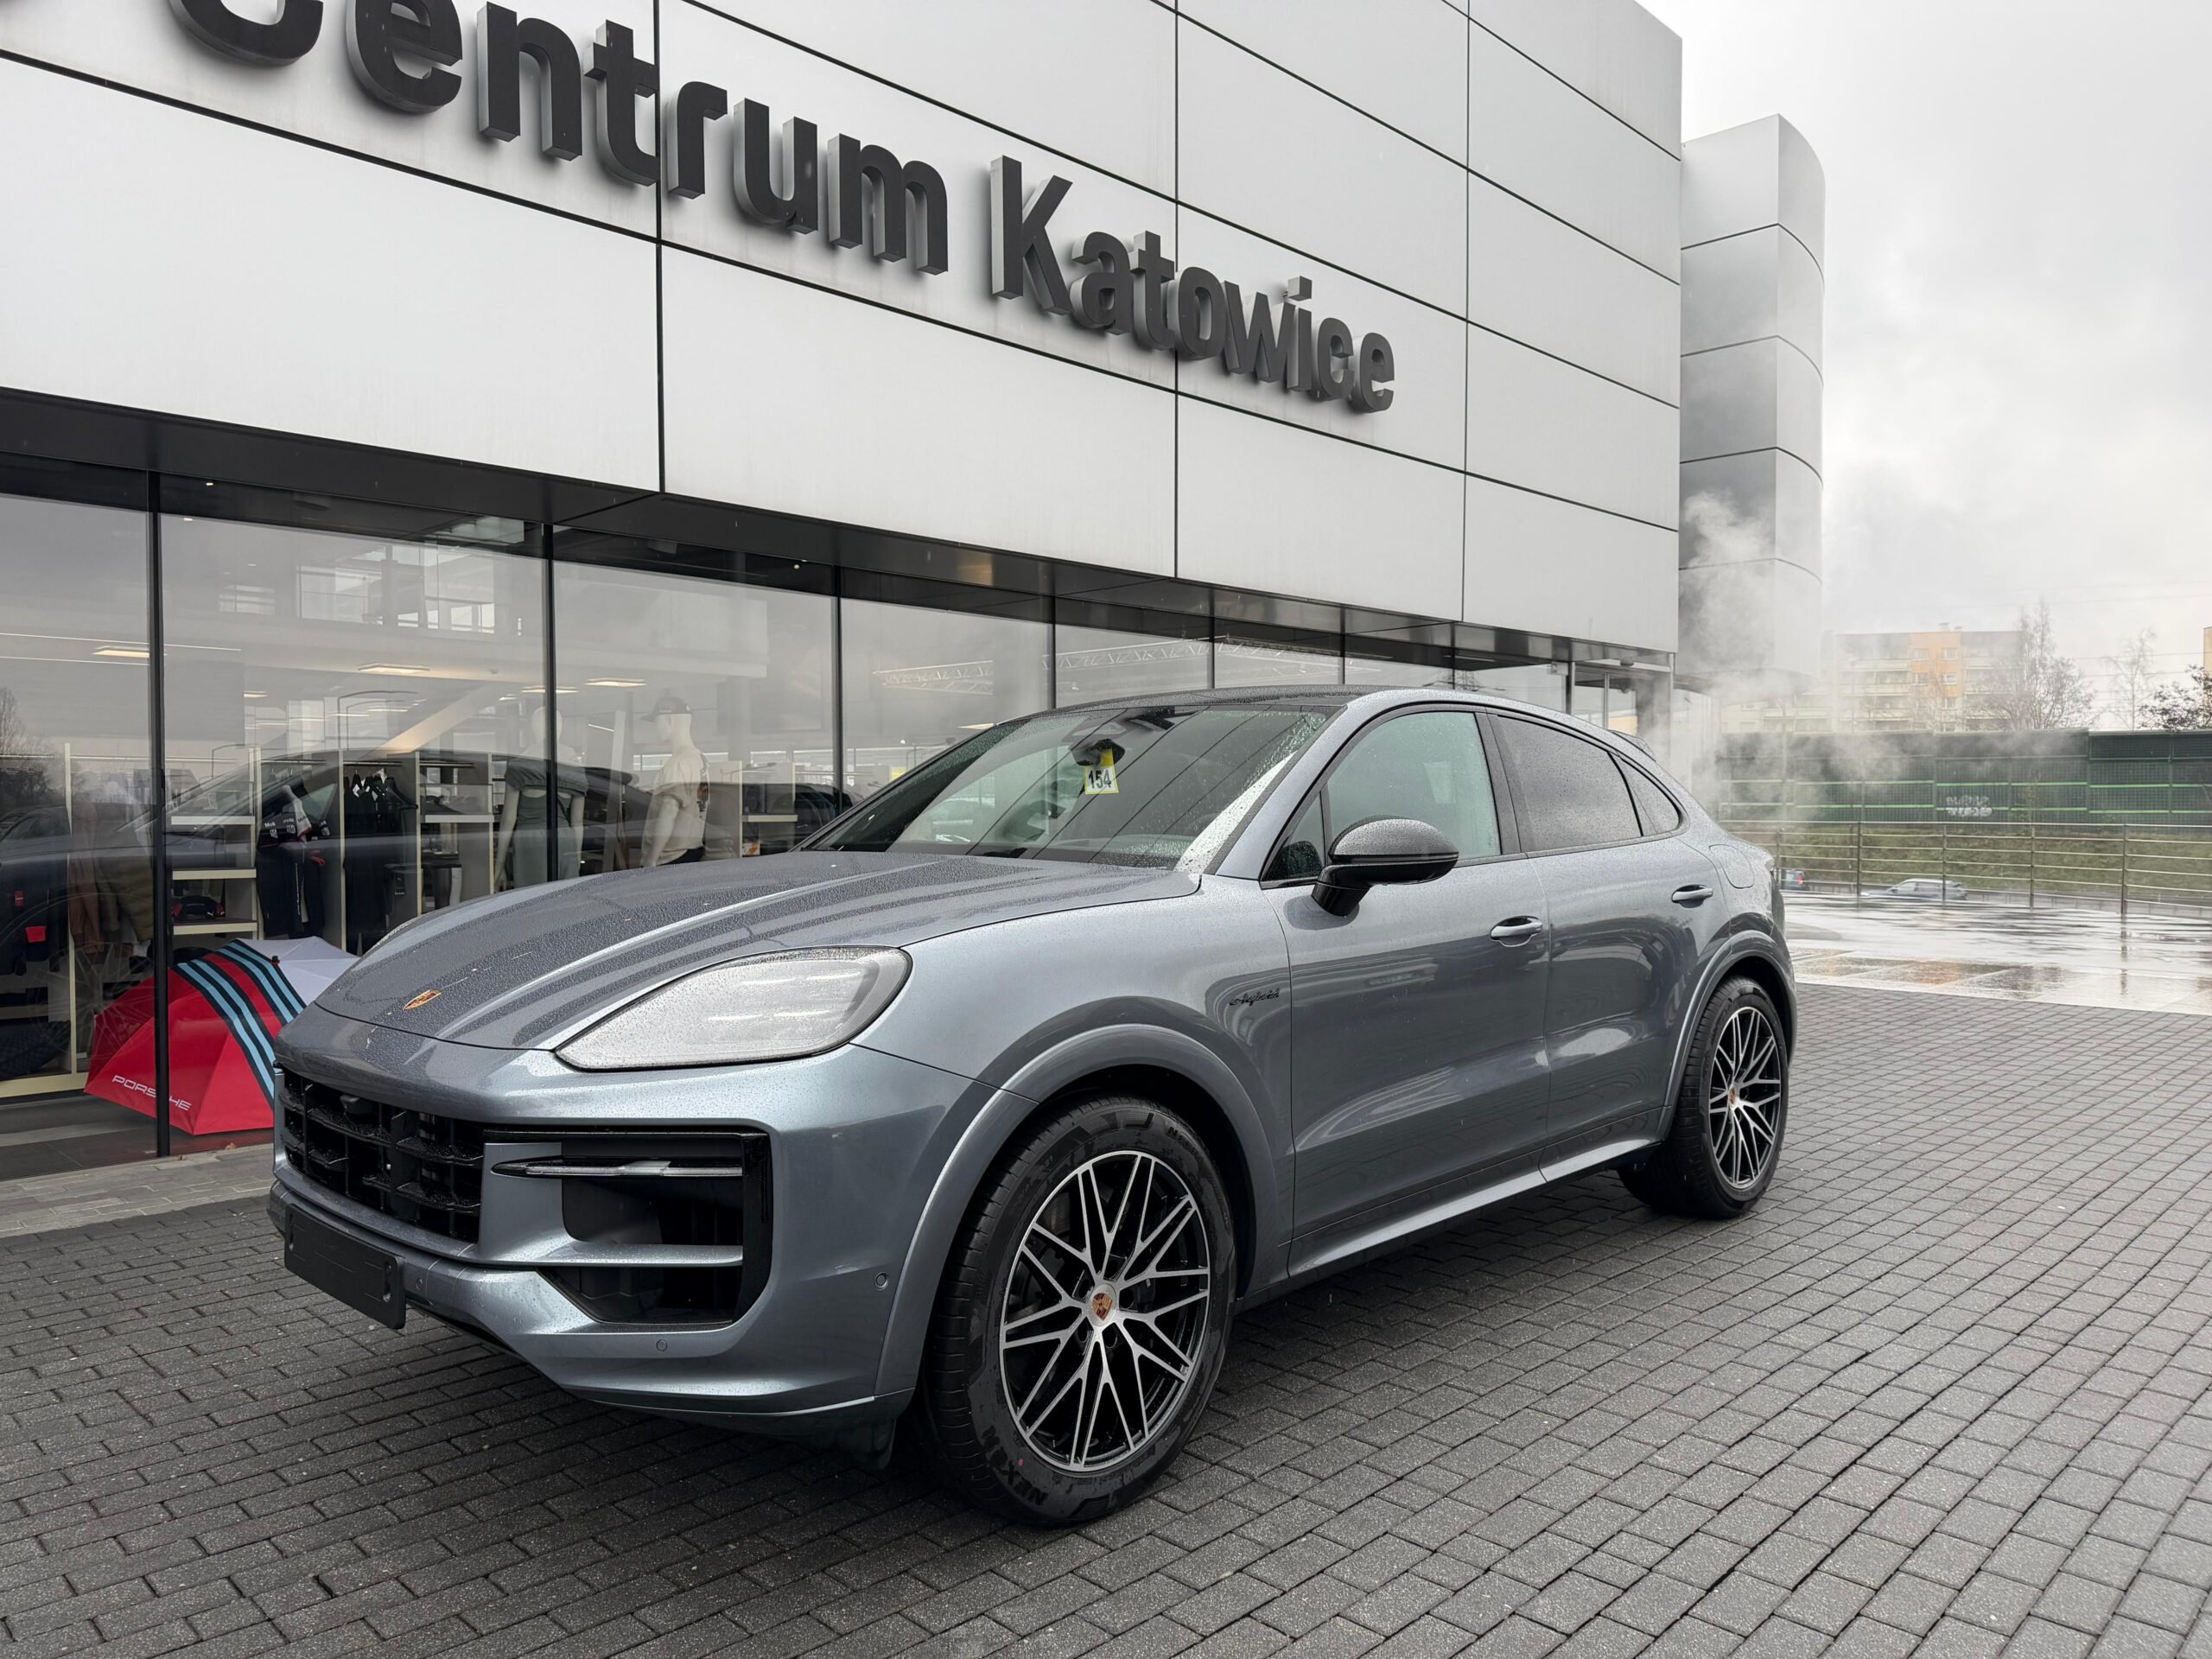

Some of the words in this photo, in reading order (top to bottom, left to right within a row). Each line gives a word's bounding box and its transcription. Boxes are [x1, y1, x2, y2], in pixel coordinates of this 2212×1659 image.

[990, 155, 1395, 412] Katowice
[1088, 769, 1112, 789] 154
[111, 1074, 192, 1111] PORSHE
